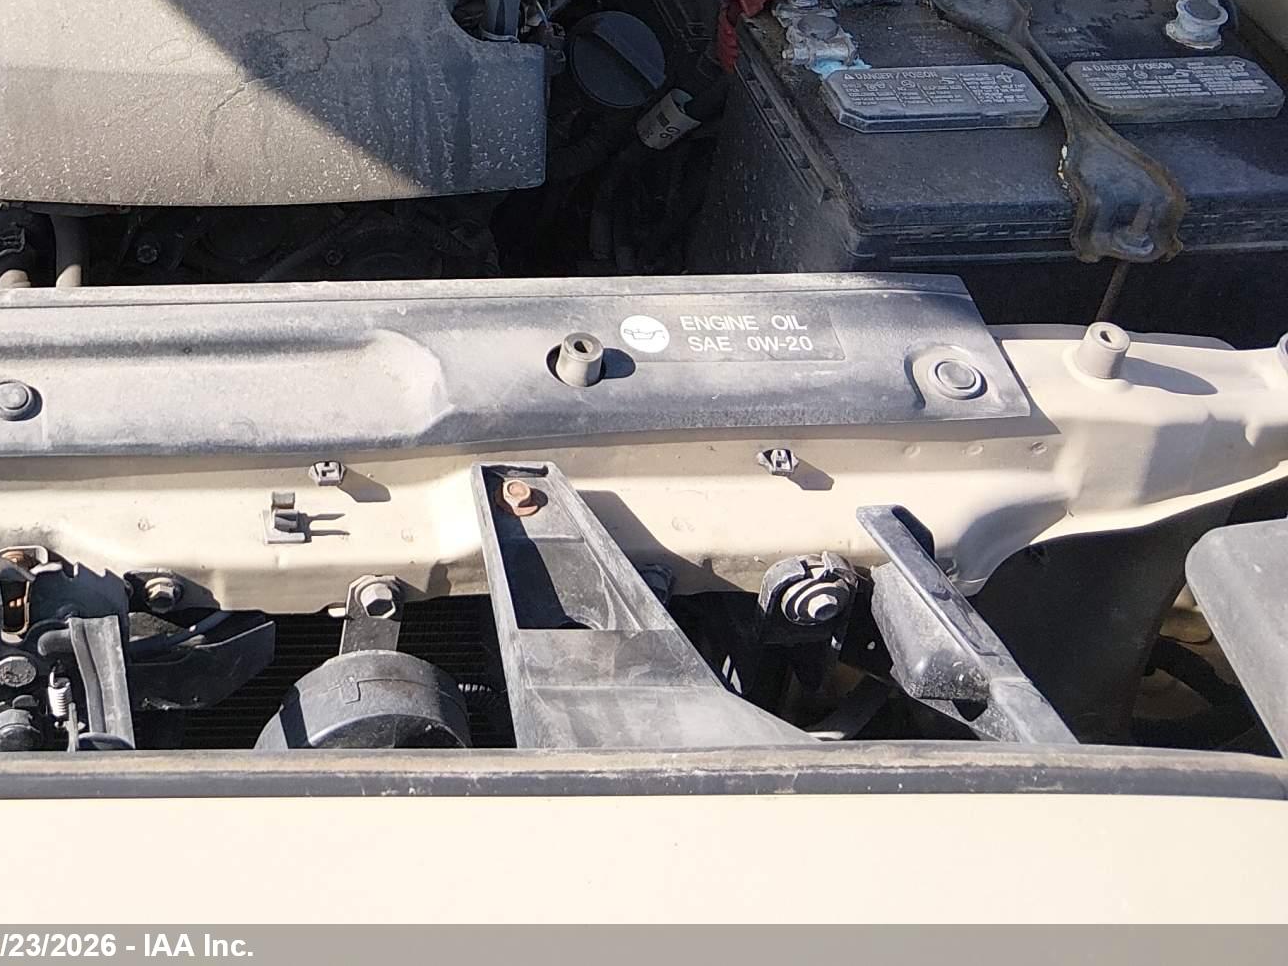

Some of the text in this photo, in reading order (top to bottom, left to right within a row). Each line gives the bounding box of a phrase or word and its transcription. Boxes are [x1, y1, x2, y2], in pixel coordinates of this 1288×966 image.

[1093, 64, 1132, 72] DANGER
[853, 72, 894, 81] DANGER
[679, 314, 808, 332] ENGINE OIL
[687, 335, 813, 352] SAE 0W-20
